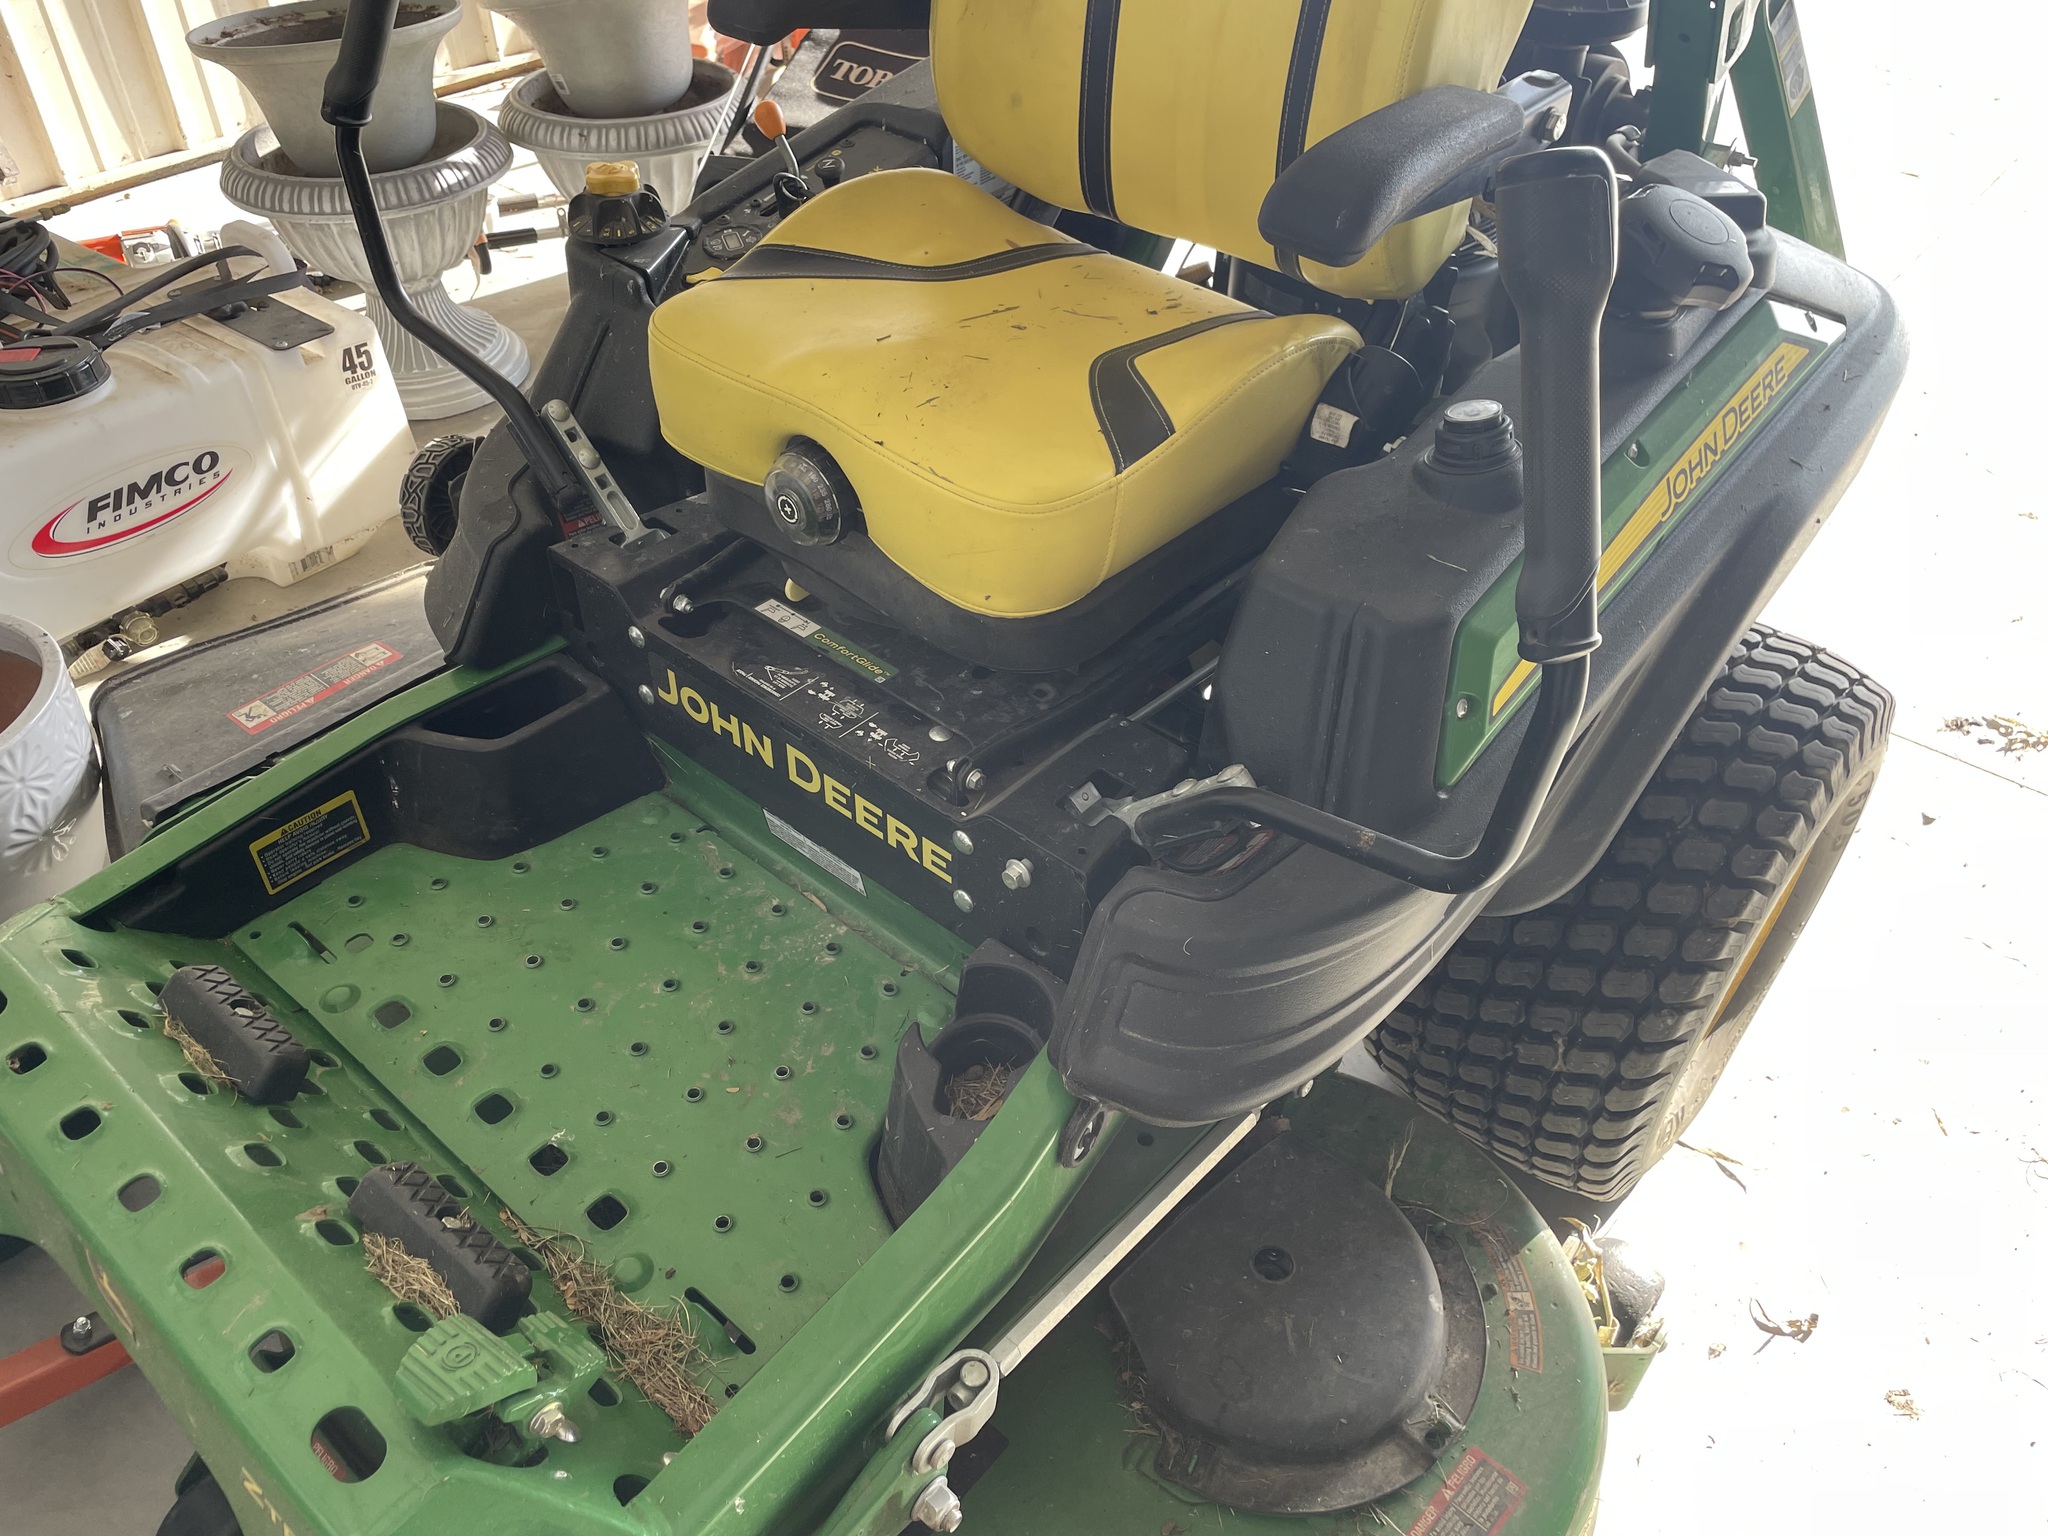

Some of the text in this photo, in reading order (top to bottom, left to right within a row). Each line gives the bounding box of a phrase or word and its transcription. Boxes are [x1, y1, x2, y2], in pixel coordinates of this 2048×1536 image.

[342, 341, 374, 375] 45
[345, 369, 376, 385] GALLON
[1661, 354, 1788, 518] JOHN DEERE
[86, 470, 221, 534] INDUSTRIES
[87, 450, 220, 524] FIMCO
[343, 664, 378, 685] DANGER
[269, 699, 309, 724] PELIGRO
[657, 668, 774, 769] JOHN
[785, 743, 952, 884] DEERE
[277, 833, 292, 844] HELP
[291, 824, 308, 836] AVOID
[287, 808, 322, 833] CAUTION
[1447, 1454, 1476, 1490] PELIGRO
